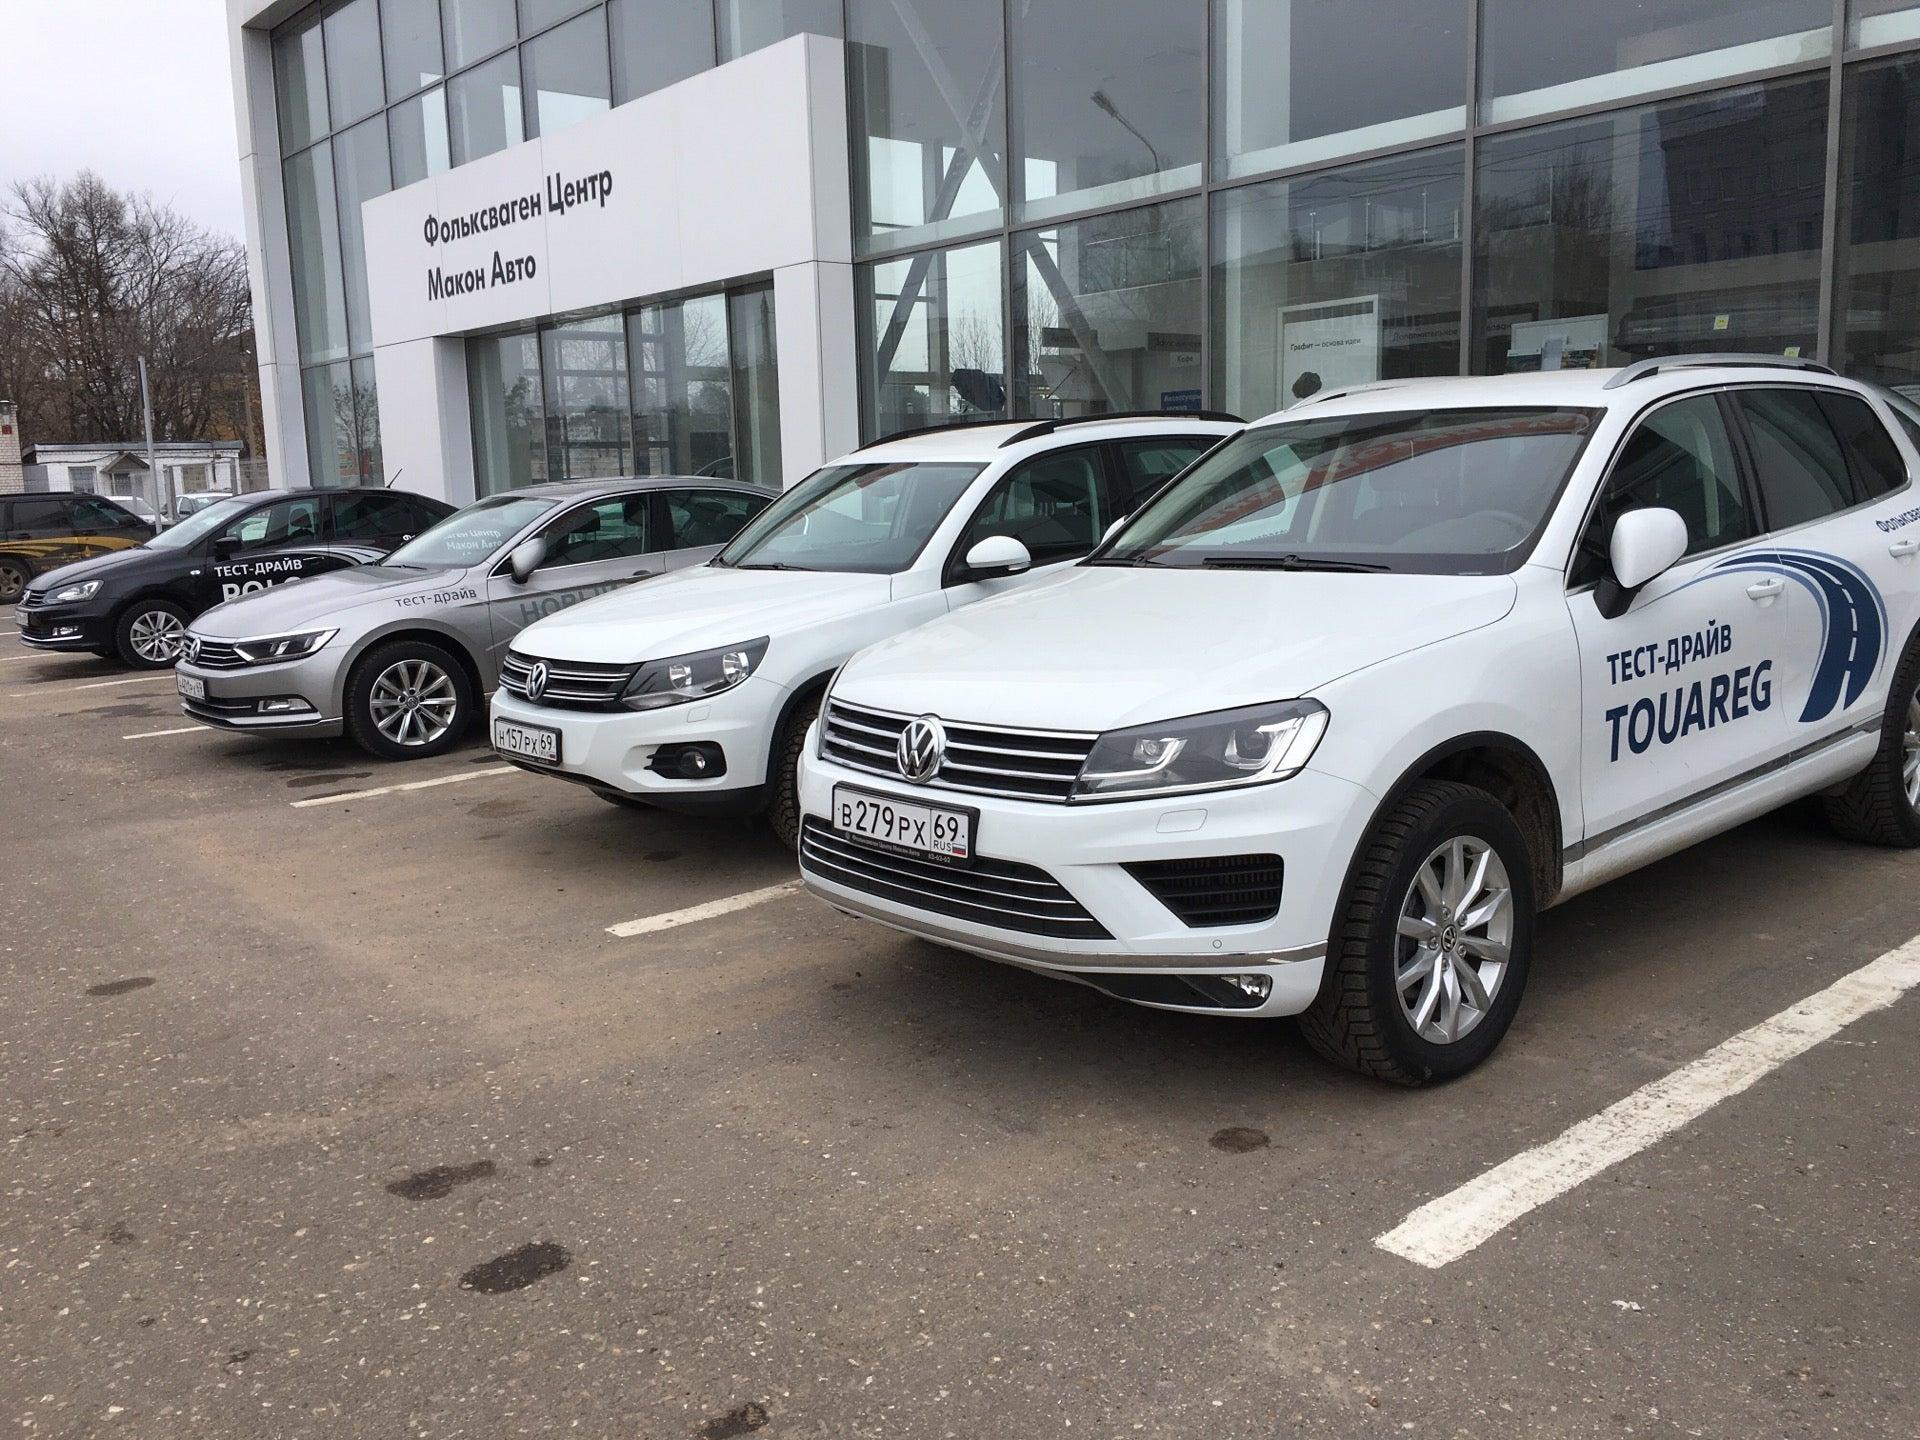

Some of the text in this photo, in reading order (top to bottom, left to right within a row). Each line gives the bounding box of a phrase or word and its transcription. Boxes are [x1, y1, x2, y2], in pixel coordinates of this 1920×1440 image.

[424, 169, 612, 246] Фольксваген Центр
[428, 251, 537, 301] Макон Авто
[1290, 343, 1313, 351] Графит
[214, 557, 303, 578] ТЕСТ-ДРАЙВ
[222, 576, 301, 602] PO
[395, 588, 477, 608] тест-драйв
[1606, 619, 1732, 686] ТЕСТ-ДРАЙВ
[1605, 660, 1773, 763] TOUAREG
[540, 734, 552, 751] 69
[933, 814, 959, 842] 69
[933, 840, 952, 853] RUS
